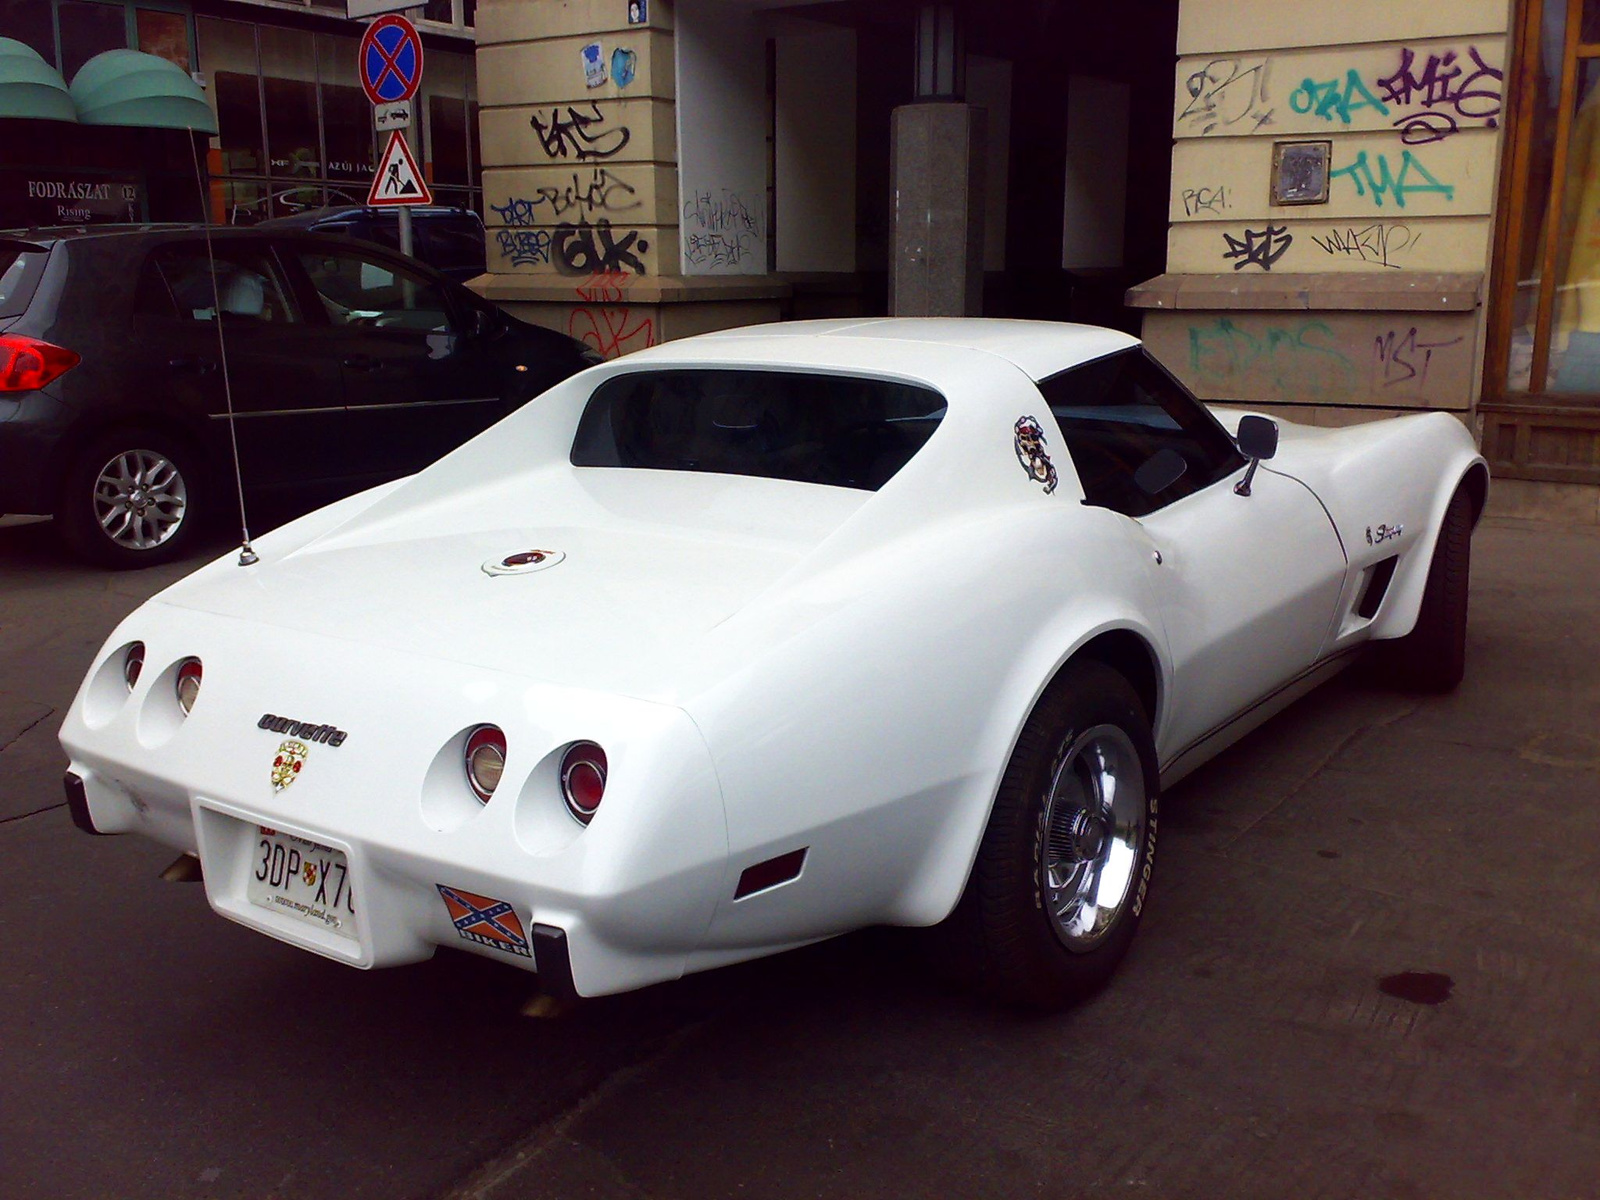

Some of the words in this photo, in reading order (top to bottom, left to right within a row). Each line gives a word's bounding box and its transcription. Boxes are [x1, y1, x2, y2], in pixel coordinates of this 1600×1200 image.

[28, 181, 110, 200] FODRÁSZAT
[57, 205, 91, 220] Rising
[256, 839, 301, 890] 3DP
[1132, 799, 1158, 917] STINGER
